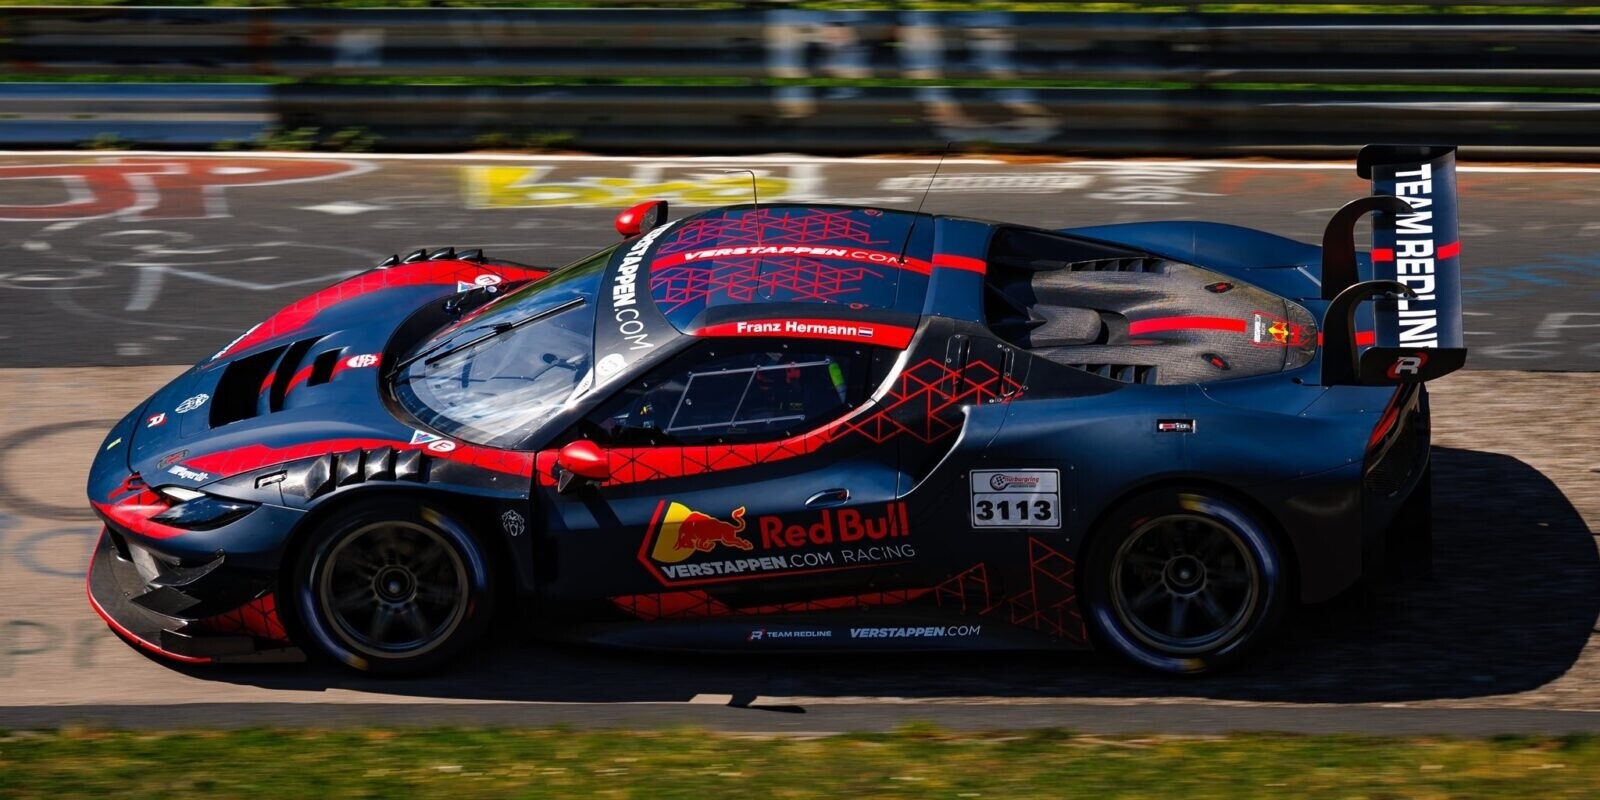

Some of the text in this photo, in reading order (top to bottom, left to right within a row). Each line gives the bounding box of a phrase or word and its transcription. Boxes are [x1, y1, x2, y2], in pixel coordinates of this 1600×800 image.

[1395, 163, 1438, 348] TEAM REDLIN
[737, 321, 857, 336] Franz Hermann
[976, 500, 1052, 521] 3113
[759, 502, 910, 550] Red Bull
[661, 544, 916, 580] VERSTAPPEN.COM RACING
[850, 625, 981, 639] VERSTAPPEN.COM
